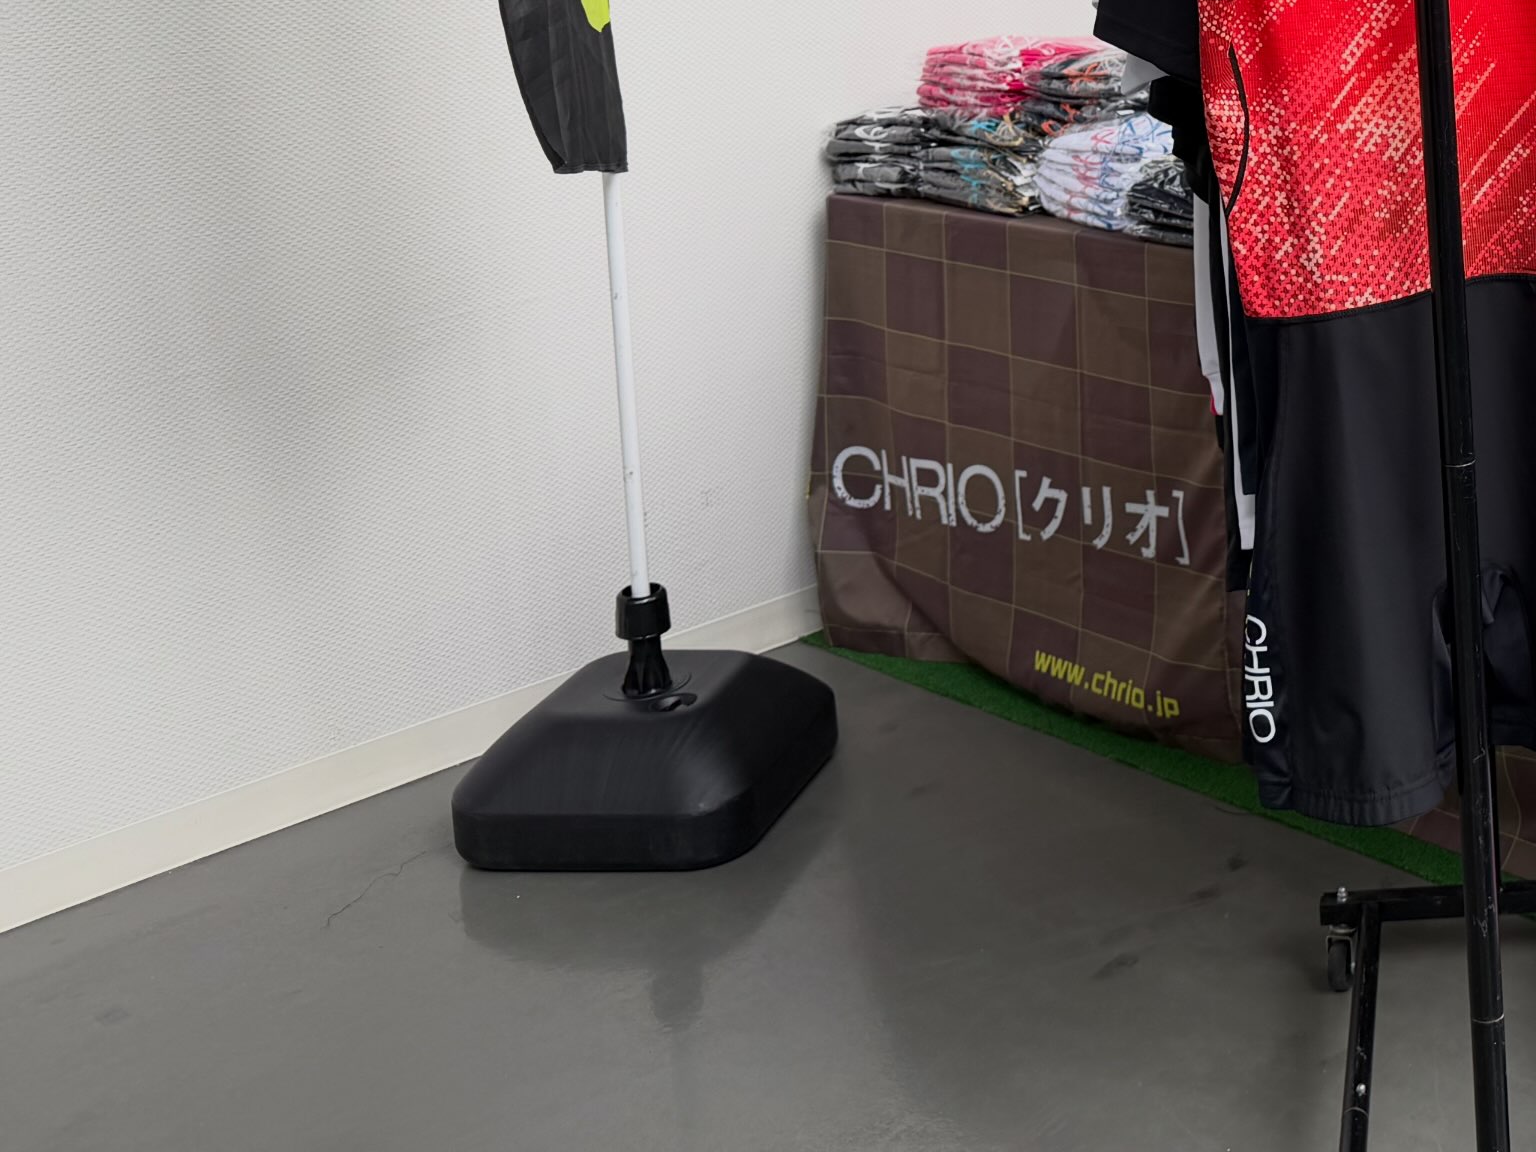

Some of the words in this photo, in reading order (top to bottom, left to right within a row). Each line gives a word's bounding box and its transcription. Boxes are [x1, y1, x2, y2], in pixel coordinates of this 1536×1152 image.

[832, 445, 1006, 533] CHRIO
[1033, 649, 1181, 720] www.chrio.jp
[1244, 613, 1277, 744] CHRIO
